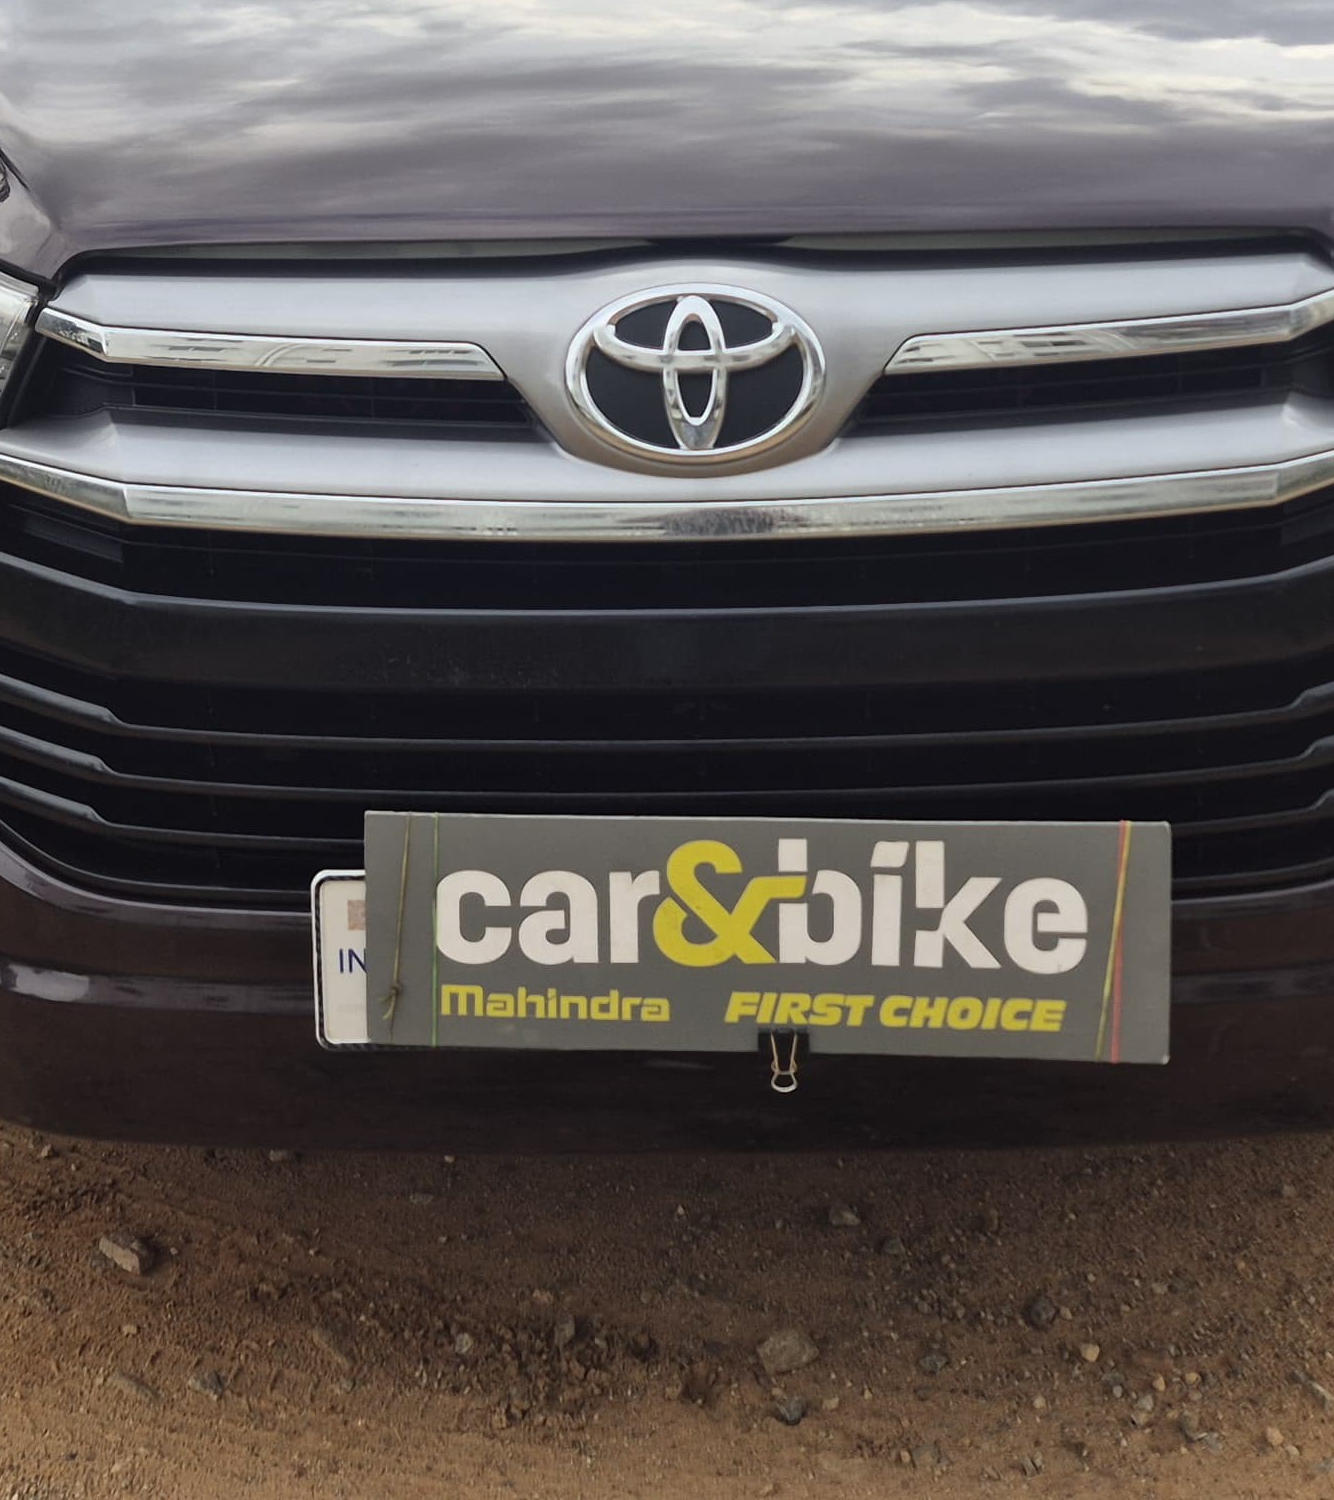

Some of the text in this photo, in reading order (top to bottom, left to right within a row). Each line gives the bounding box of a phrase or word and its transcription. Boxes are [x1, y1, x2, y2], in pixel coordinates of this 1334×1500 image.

[435, 837, 1089, 975] car&bike
[440, 984, 1067, 1032] Mahindra FIRST CHOICE
